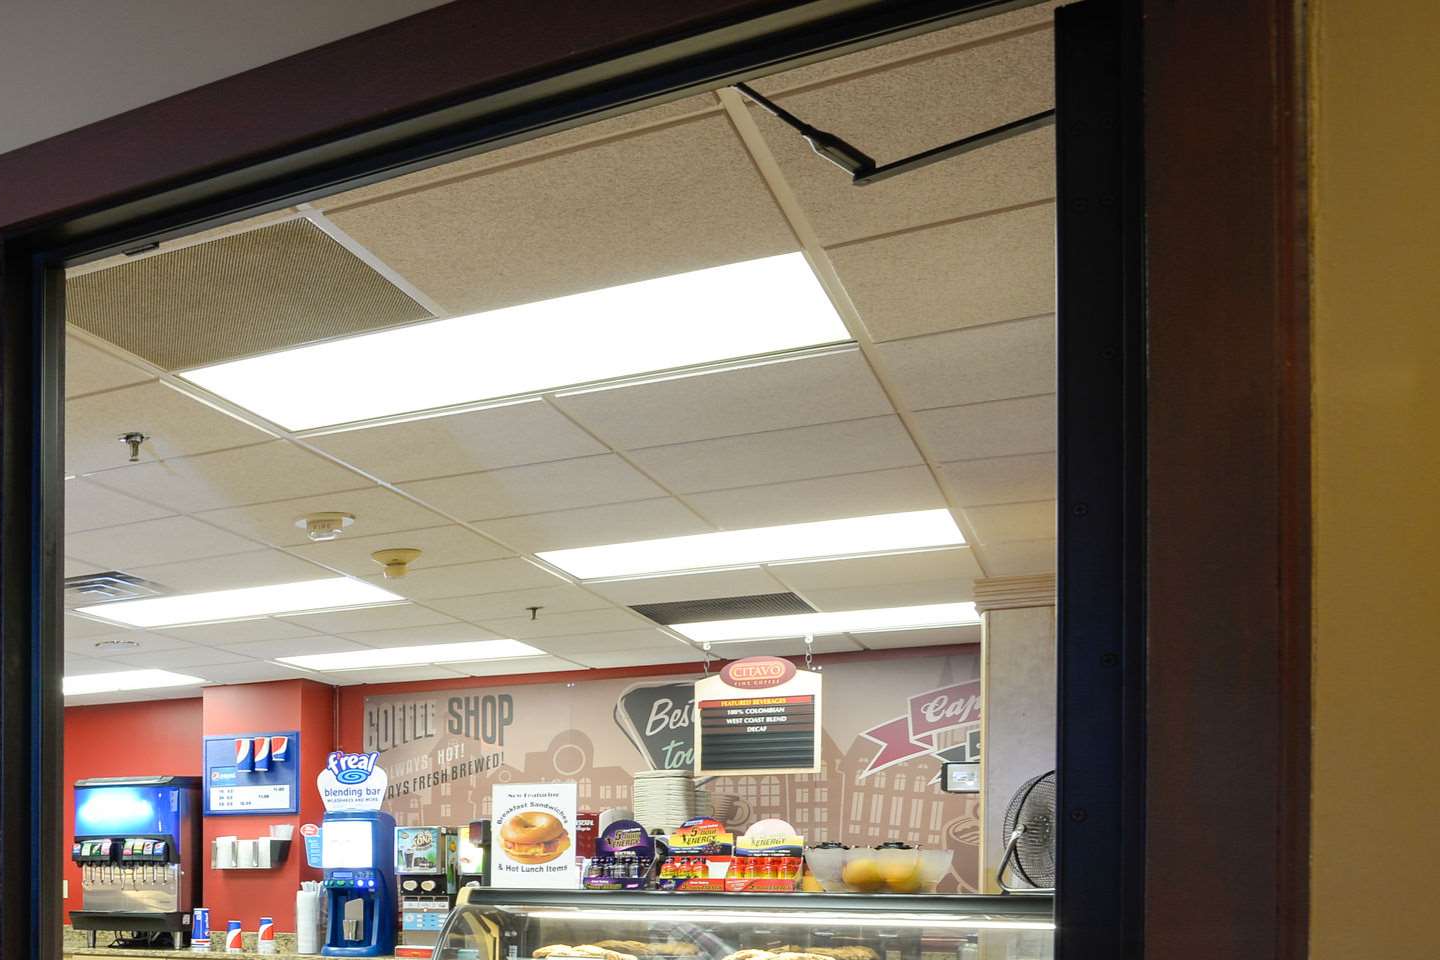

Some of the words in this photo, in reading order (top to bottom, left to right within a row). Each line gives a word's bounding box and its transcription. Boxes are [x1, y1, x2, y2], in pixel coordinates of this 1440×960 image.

[732, 664, 781, 678] CITAVO
[745, 707, 785, 715] COLOMBIAN
[448, 694, 513, 746] SHOP
[744, 716, 765, 724] COAST
[437, 742, 465, 765] HOT!
[413, 769, 448, 792] FRESH
[451, 752, 504, 781] BREWED!
[324, 788, 362, 797] blending
[365, 788, 381, 796] bar
[530, 802, 568, 824] Sandwiches
[521, 865, 544, 873] Lunch
[546, 864, 568, 873] Items
